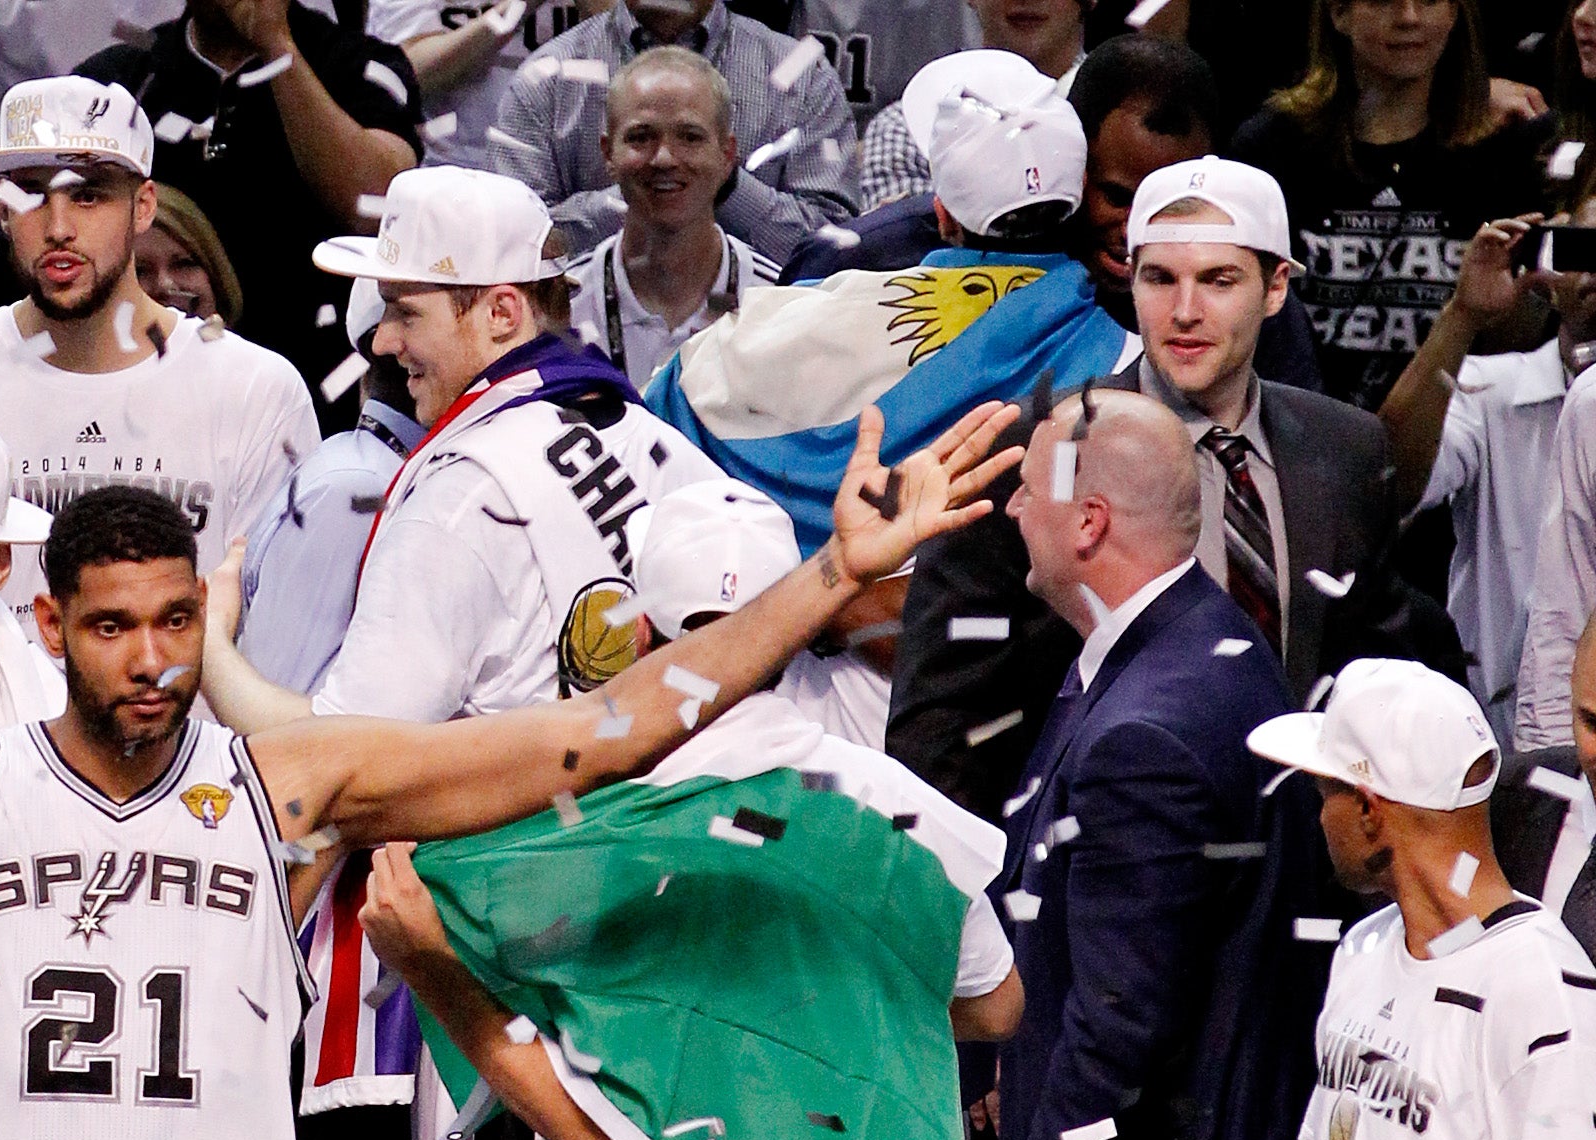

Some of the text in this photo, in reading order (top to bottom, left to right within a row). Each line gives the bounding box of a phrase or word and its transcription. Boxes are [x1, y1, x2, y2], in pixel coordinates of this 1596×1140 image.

[1300, 229, 1470, 283] TEXAS
[22, 456, 162, 475] 2014 NBA
[19, 960, 202, 1109] 21
